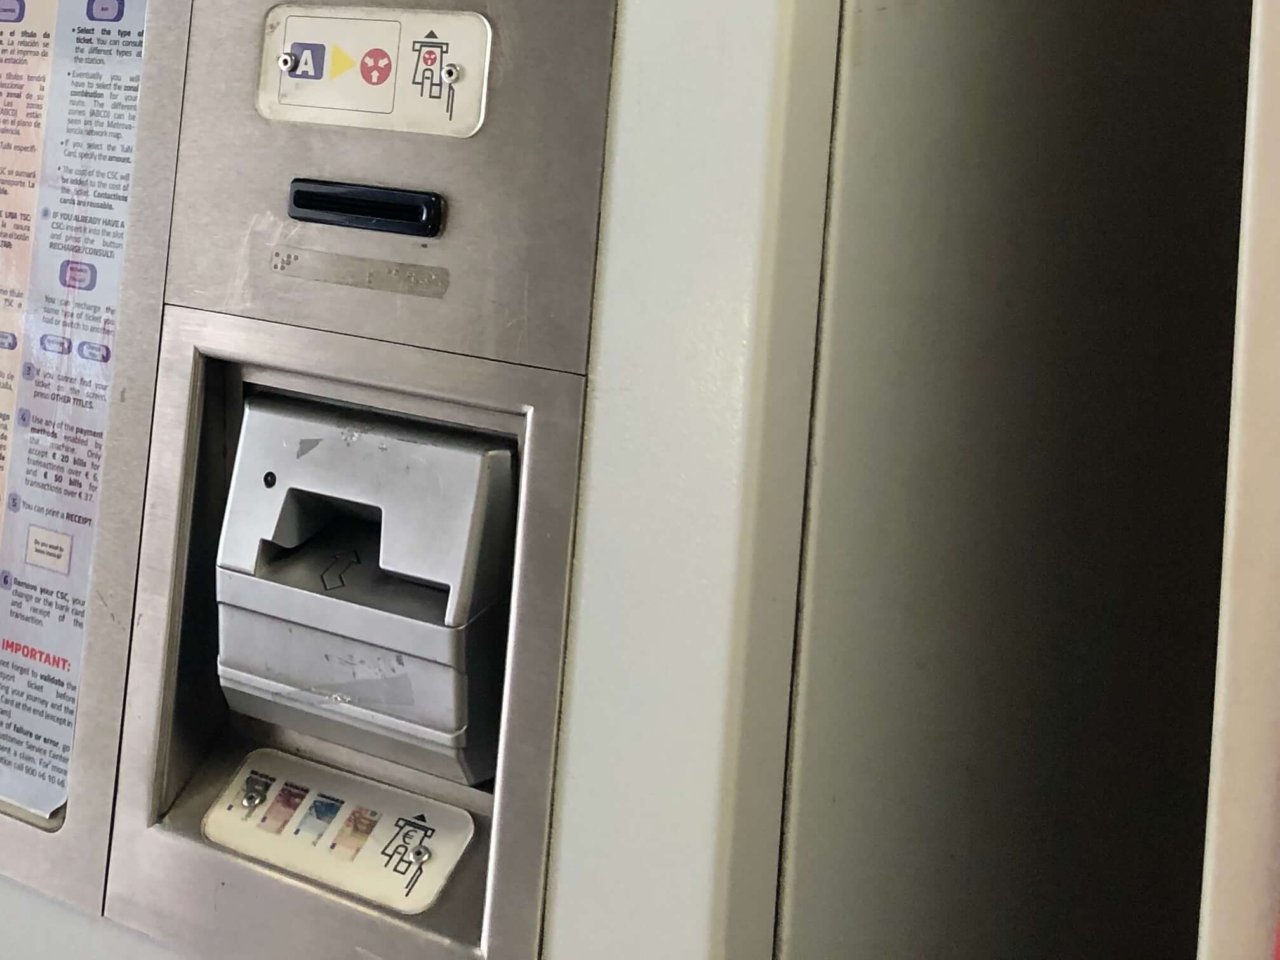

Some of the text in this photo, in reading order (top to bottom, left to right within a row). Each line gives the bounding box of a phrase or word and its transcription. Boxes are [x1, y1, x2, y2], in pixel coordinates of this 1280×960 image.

[76, 26, 95, 35] Select
[296, 48, 315, 77] A
[1, 637, 72, 674] IMPORTANT:
